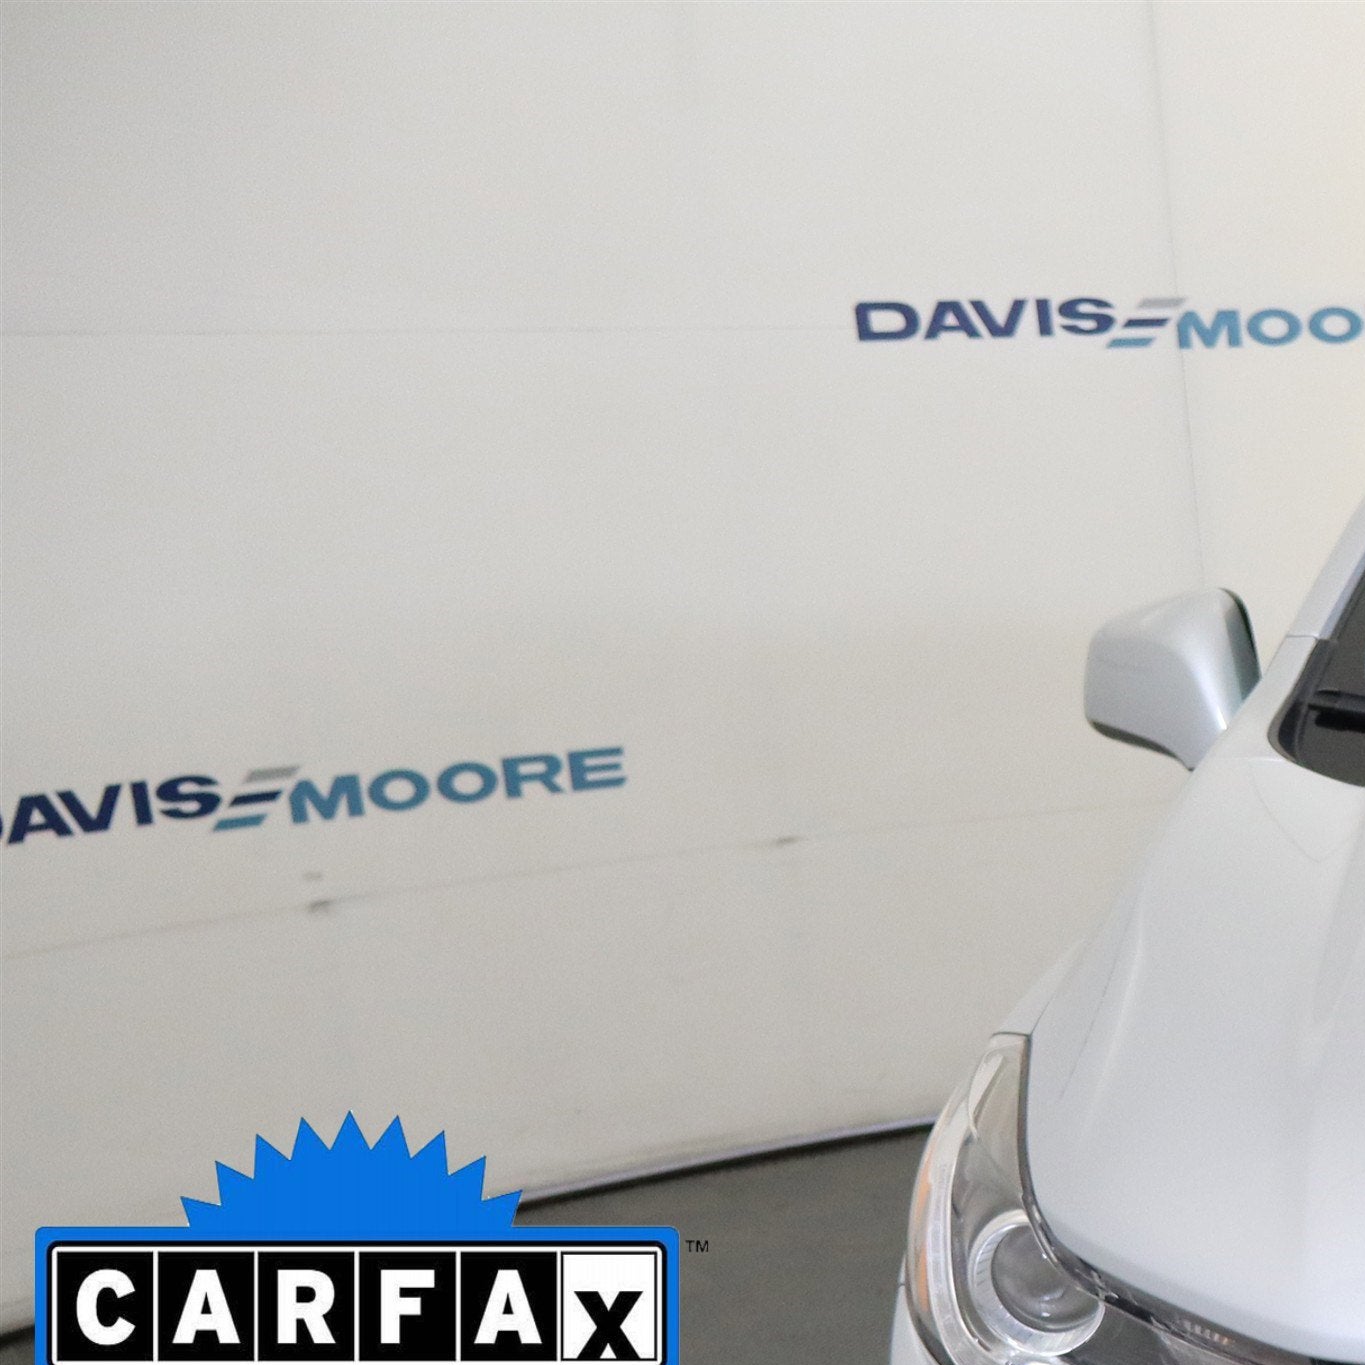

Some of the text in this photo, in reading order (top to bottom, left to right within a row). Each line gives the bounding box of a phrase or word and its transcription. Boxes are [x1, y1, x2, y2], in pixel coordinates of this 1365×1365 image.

[854, 297, 1117, 342] DAVIS
[0, 746, 627, 845] AVIS MOORE
